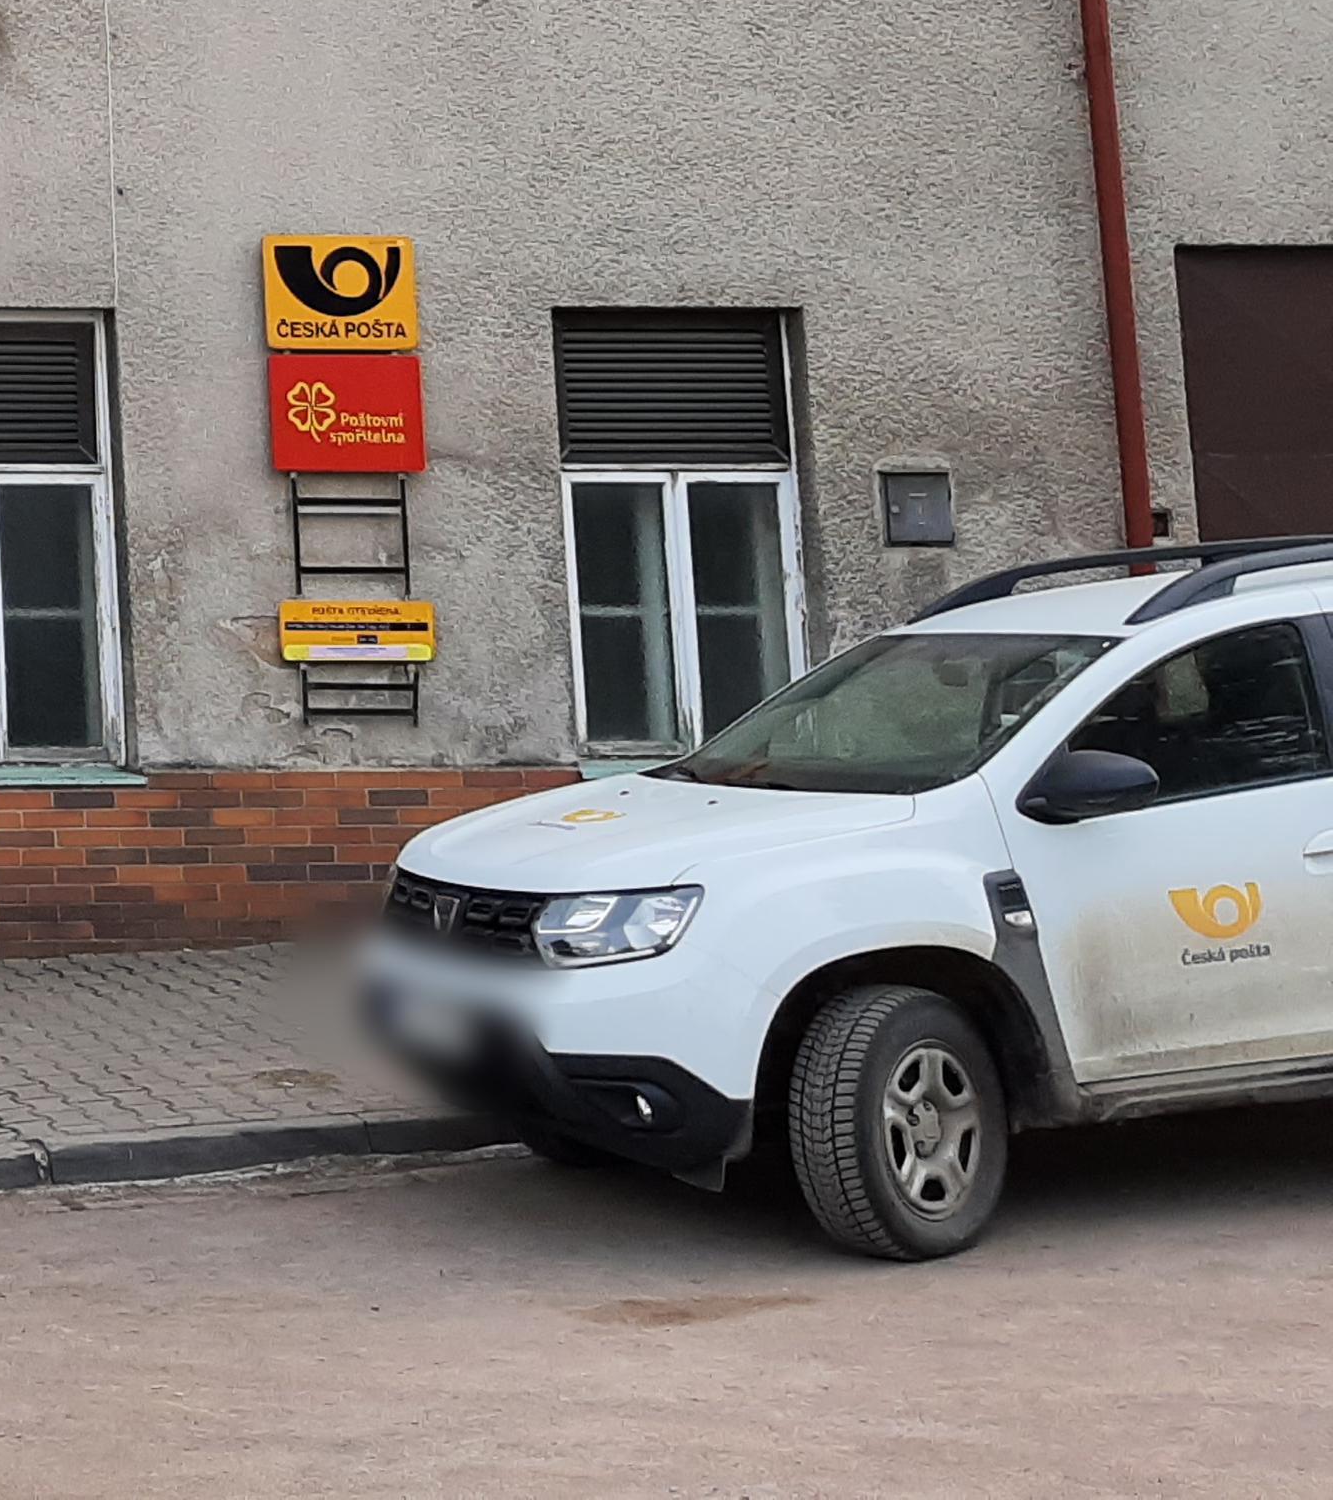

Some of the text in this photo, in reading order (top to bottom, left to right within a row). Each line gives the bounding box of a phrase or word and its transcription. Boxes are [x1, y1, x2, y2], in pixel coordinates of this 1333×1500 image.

[276, 318, 406, 339] ČESKÁ POŠTA
[339, 410, 404, 428] Poštovní
[329, 428, 406, 447] spořitelna
[1181, 943, 1271, 966] Česká pošta
